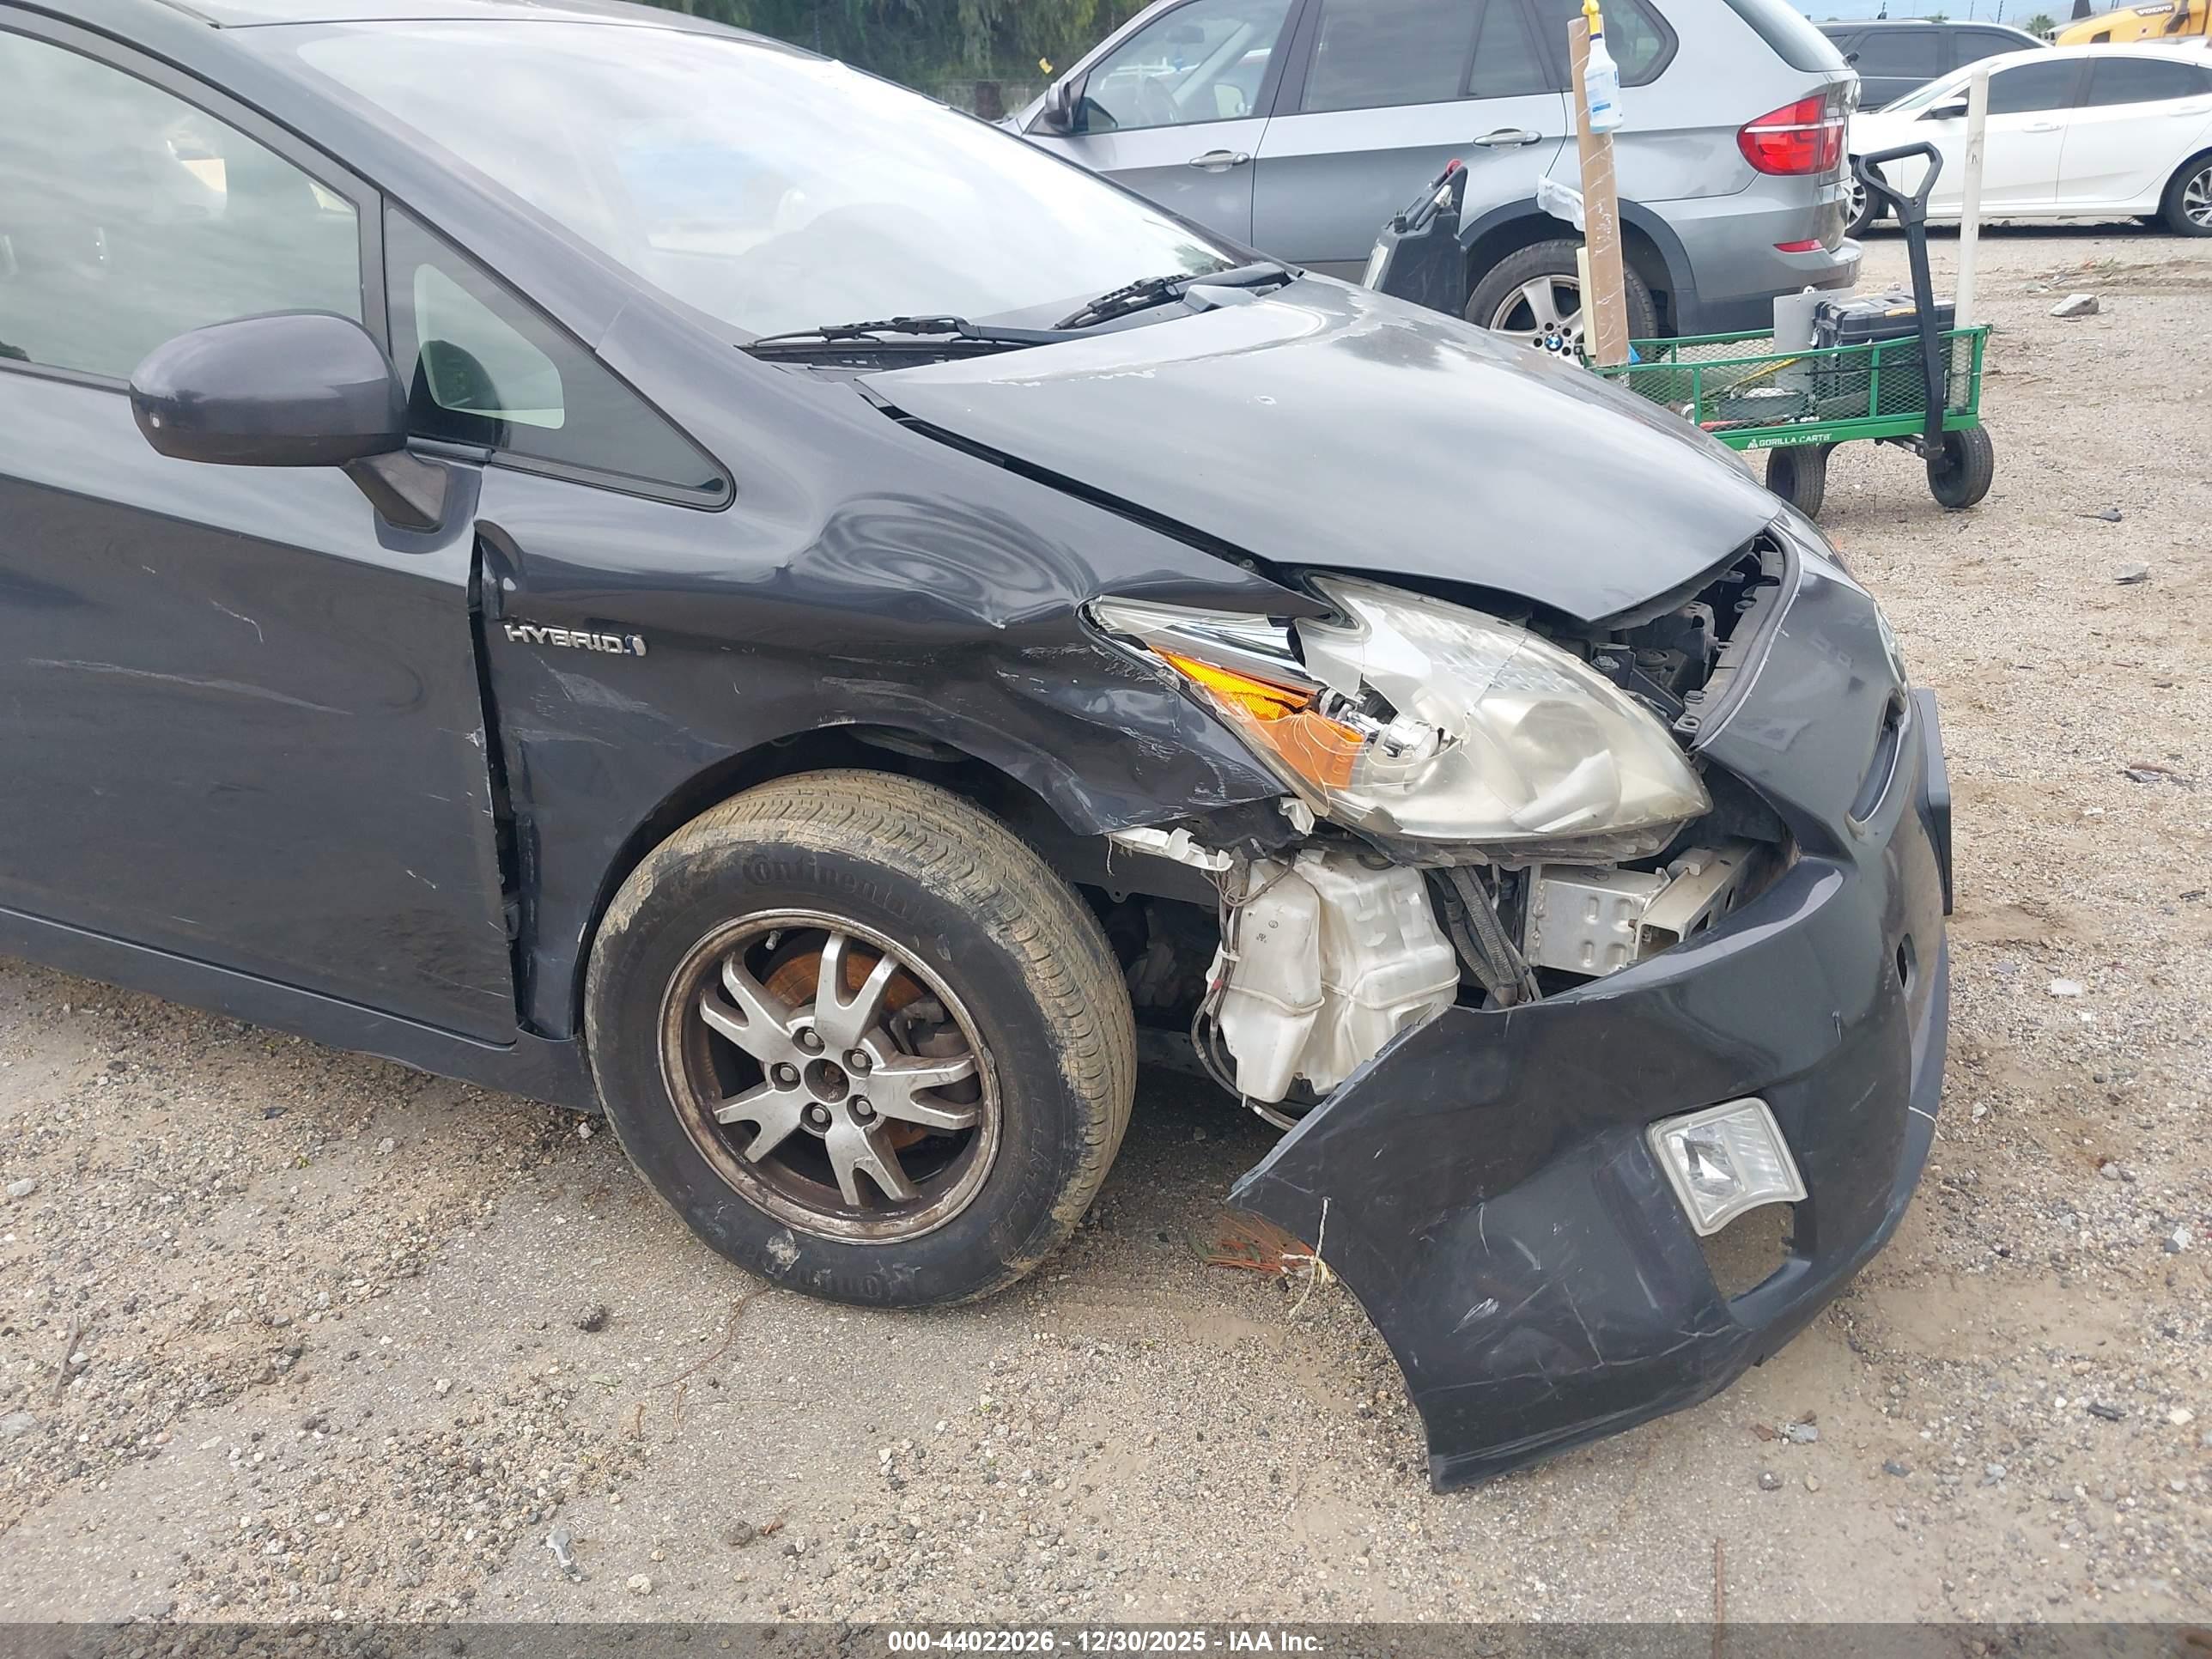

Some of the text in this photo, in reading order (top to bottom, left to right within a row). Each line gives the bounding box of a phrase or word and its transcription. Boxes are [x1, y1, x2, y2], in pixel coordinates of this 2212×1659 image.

[2136, 6, 2172, 15] VOLVO
[1759, 436, 1796, 447] GORILLA
[503, 624, 623, 654] HYBRID
